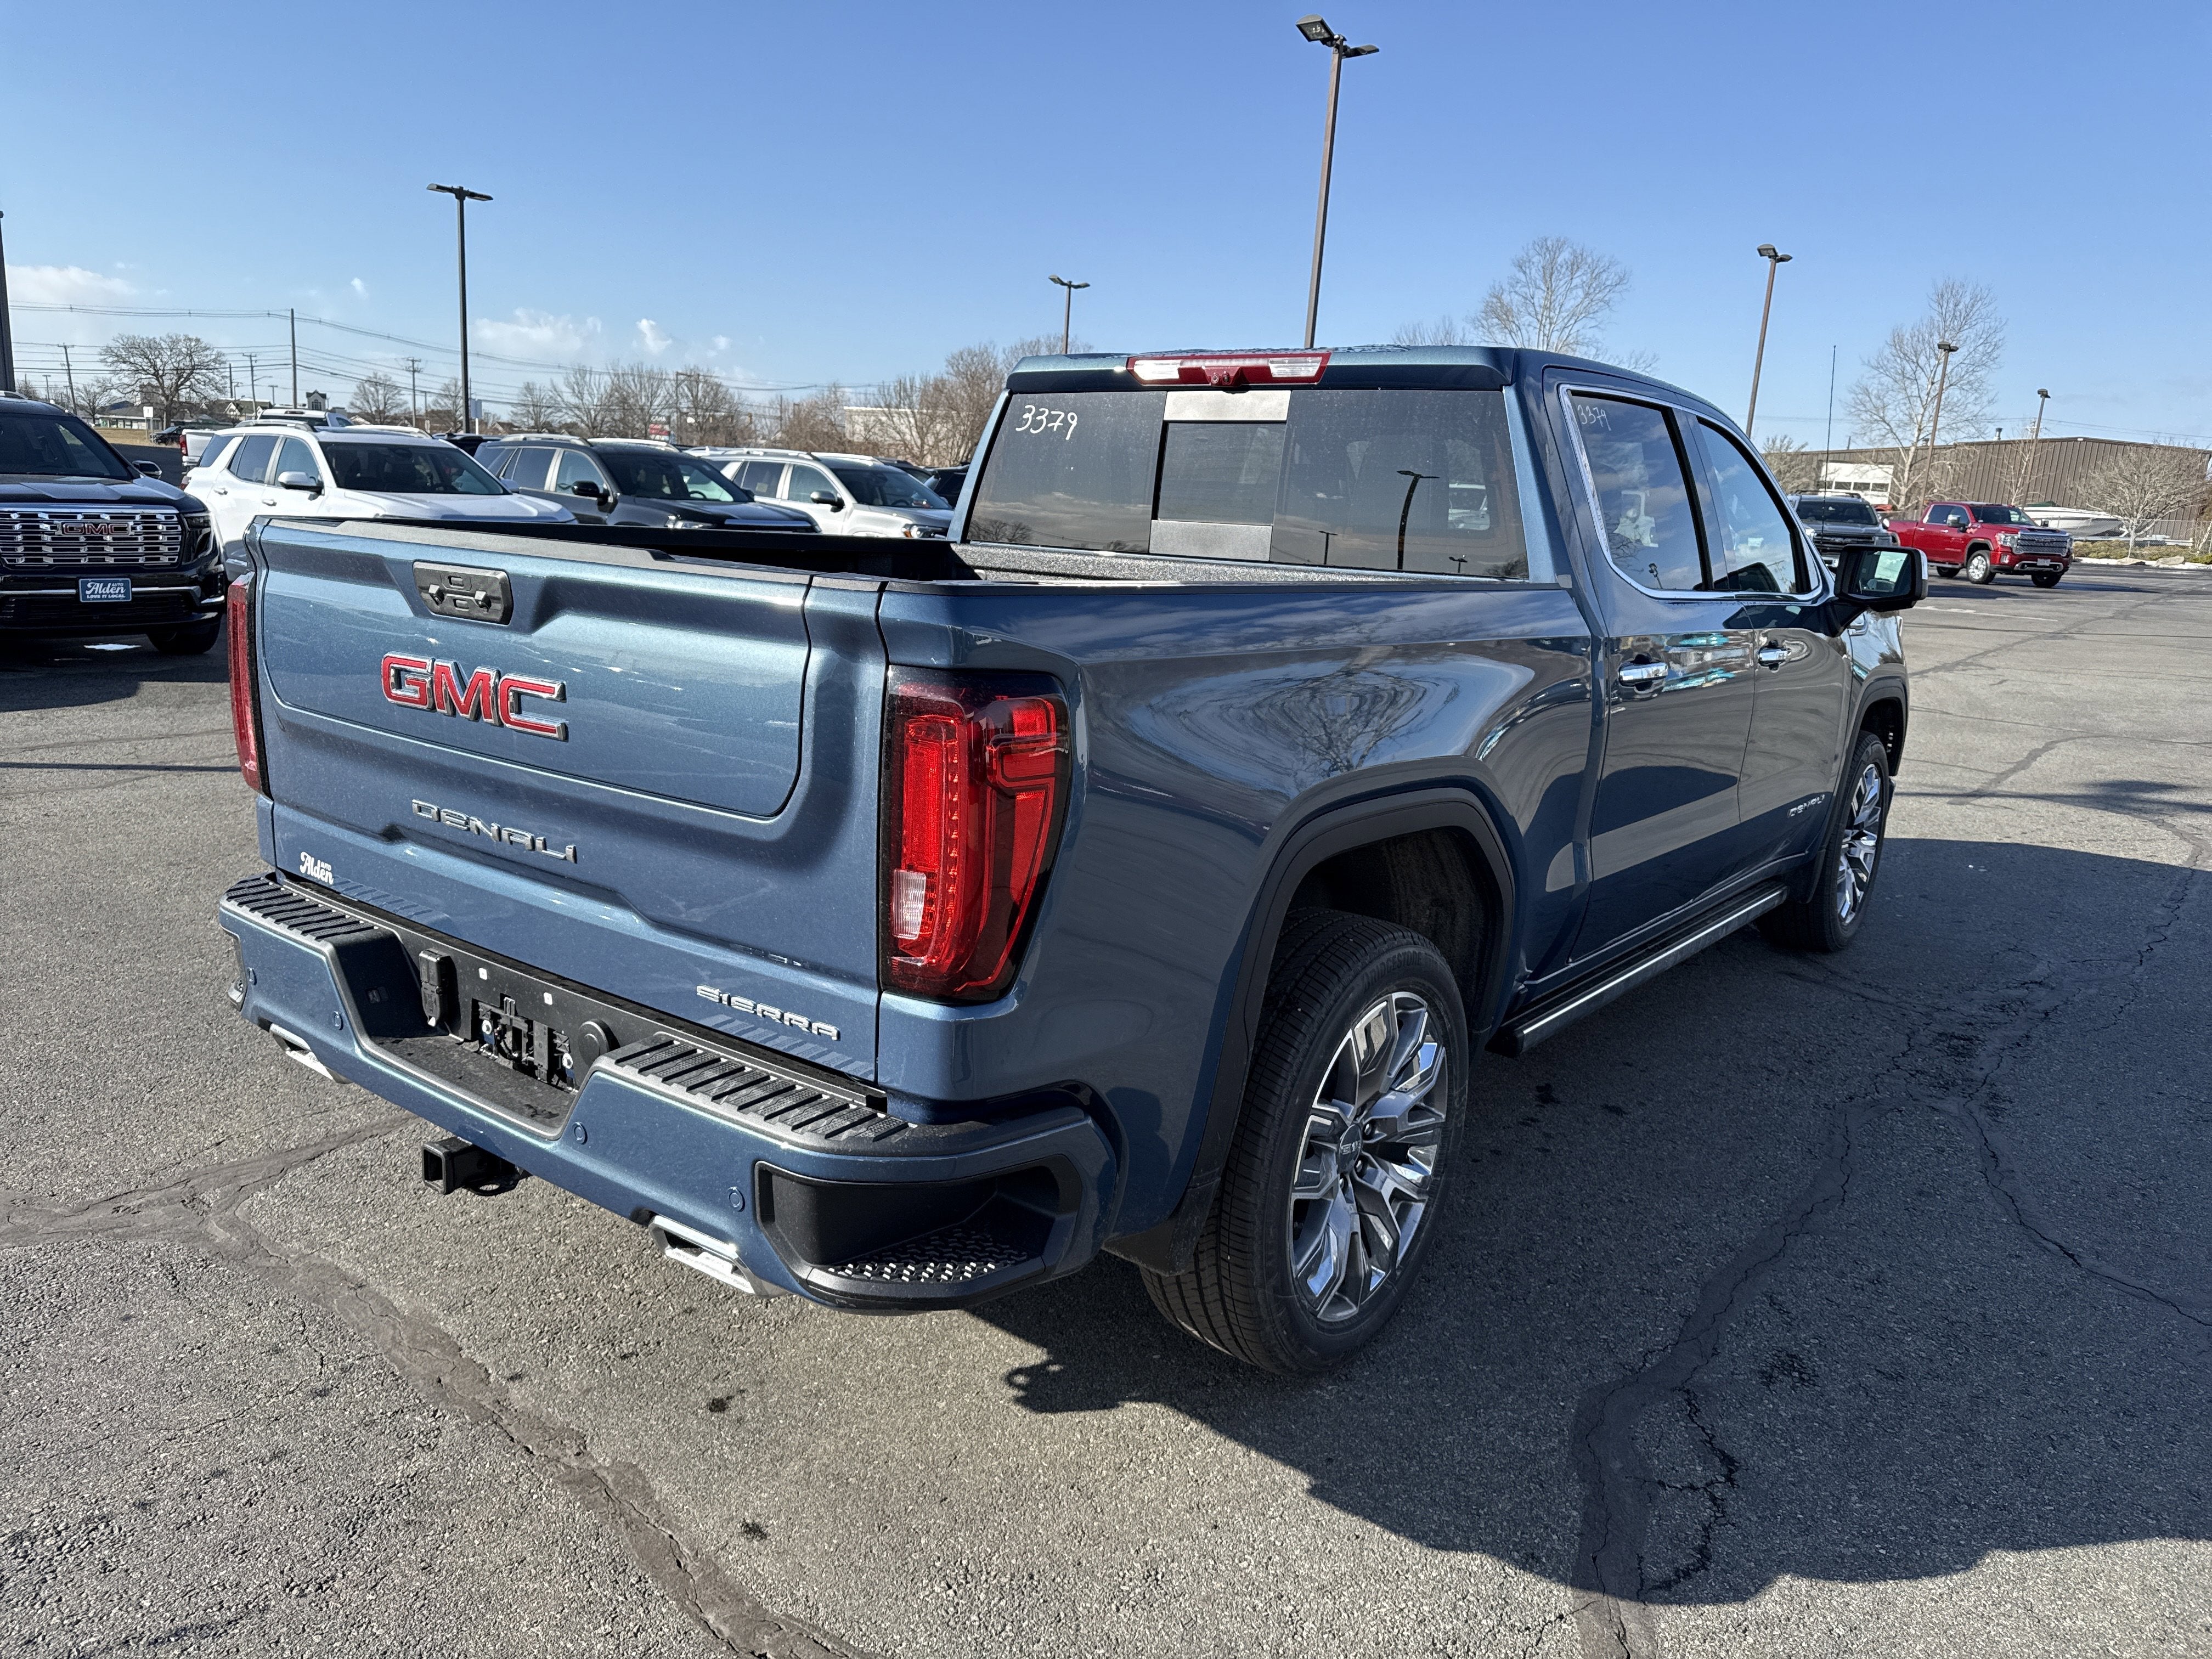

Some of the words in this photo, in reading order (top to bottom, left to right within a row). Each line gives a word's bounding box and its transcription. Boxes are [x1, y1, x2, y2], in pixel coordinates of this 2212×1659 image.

[1015, 404, 1077, 441] 3379
[1577, 404, 1611, 431] 3379
[63, 523, 129, 535] GMC
[86, 582, 126, 594] Alden
[381, 651, 569, 742] GMC
[300, 851, 334, 884] Alden
[320, 861, 331, 871] AUTO
[696, 984, 841, 1041] SIERRA
